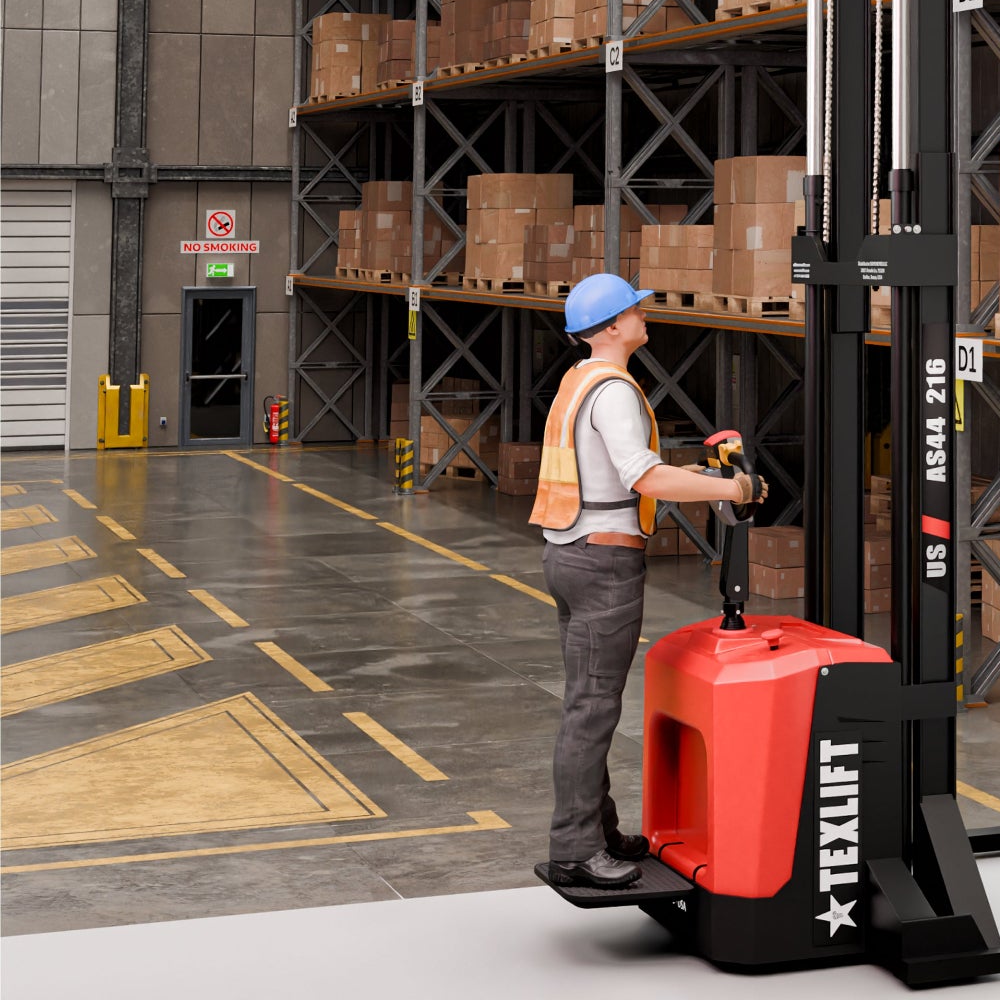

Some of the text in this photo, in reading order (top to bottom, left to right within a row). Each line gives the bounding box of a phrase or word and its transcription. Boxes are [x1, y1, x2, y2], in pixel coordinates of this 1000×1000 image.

[610, 46, 620, 66] C2
[415, 85, 421, 101] B2
[183, 243, 257, 252] NO SMOKING
[412, 291, 418, 306] B1
[958, 345, 976, 373] D1
[925, 358, 947, 482] AS44 216
[925, 543, 947, 578] US
[819, 740, 859, 893] TEXLIFT
